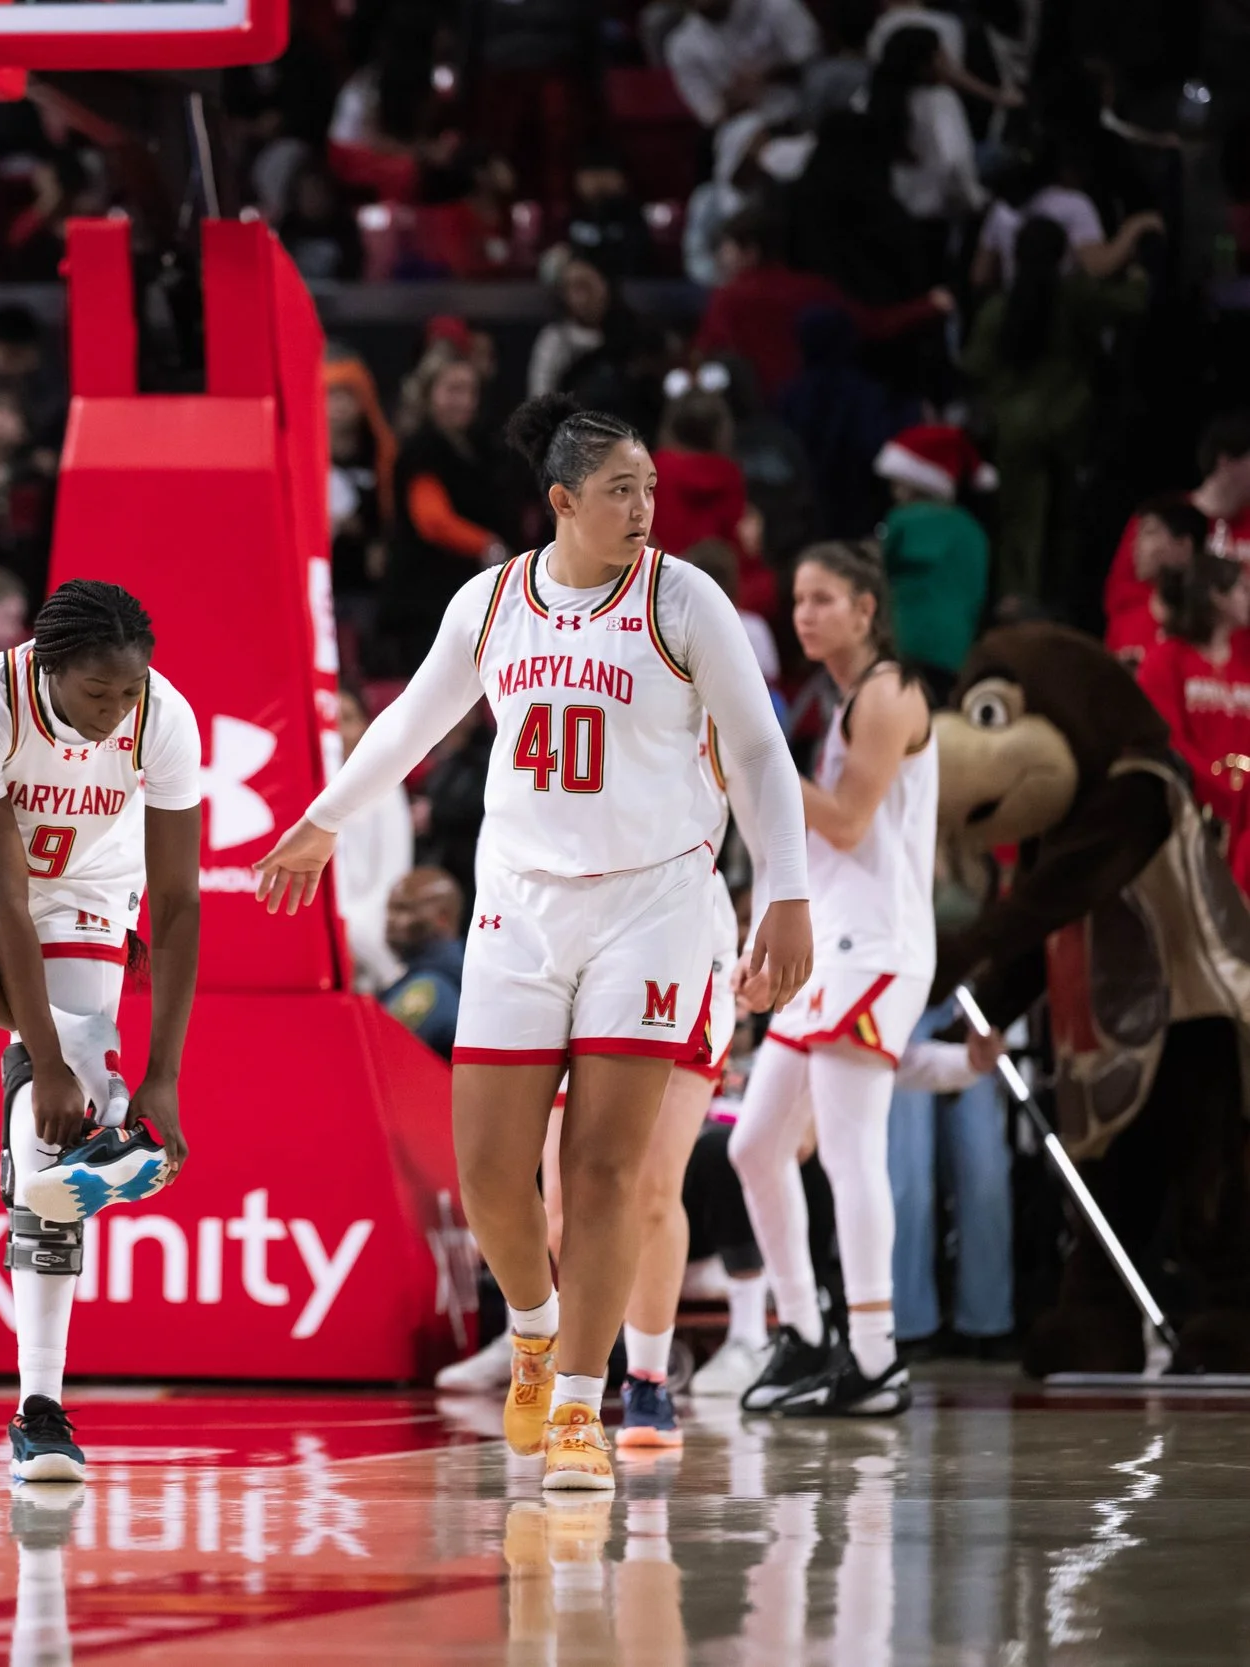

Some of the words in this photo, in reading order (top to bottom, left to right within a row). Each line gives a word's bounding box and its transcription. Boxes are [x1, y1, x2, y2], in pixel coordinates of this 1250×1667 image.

[498, 655, 633, 705] MARYLAND
[513, 703, 605, 793] 40
[28, 825, 76, 878] 9
[641, 979, 680, 1022] M
